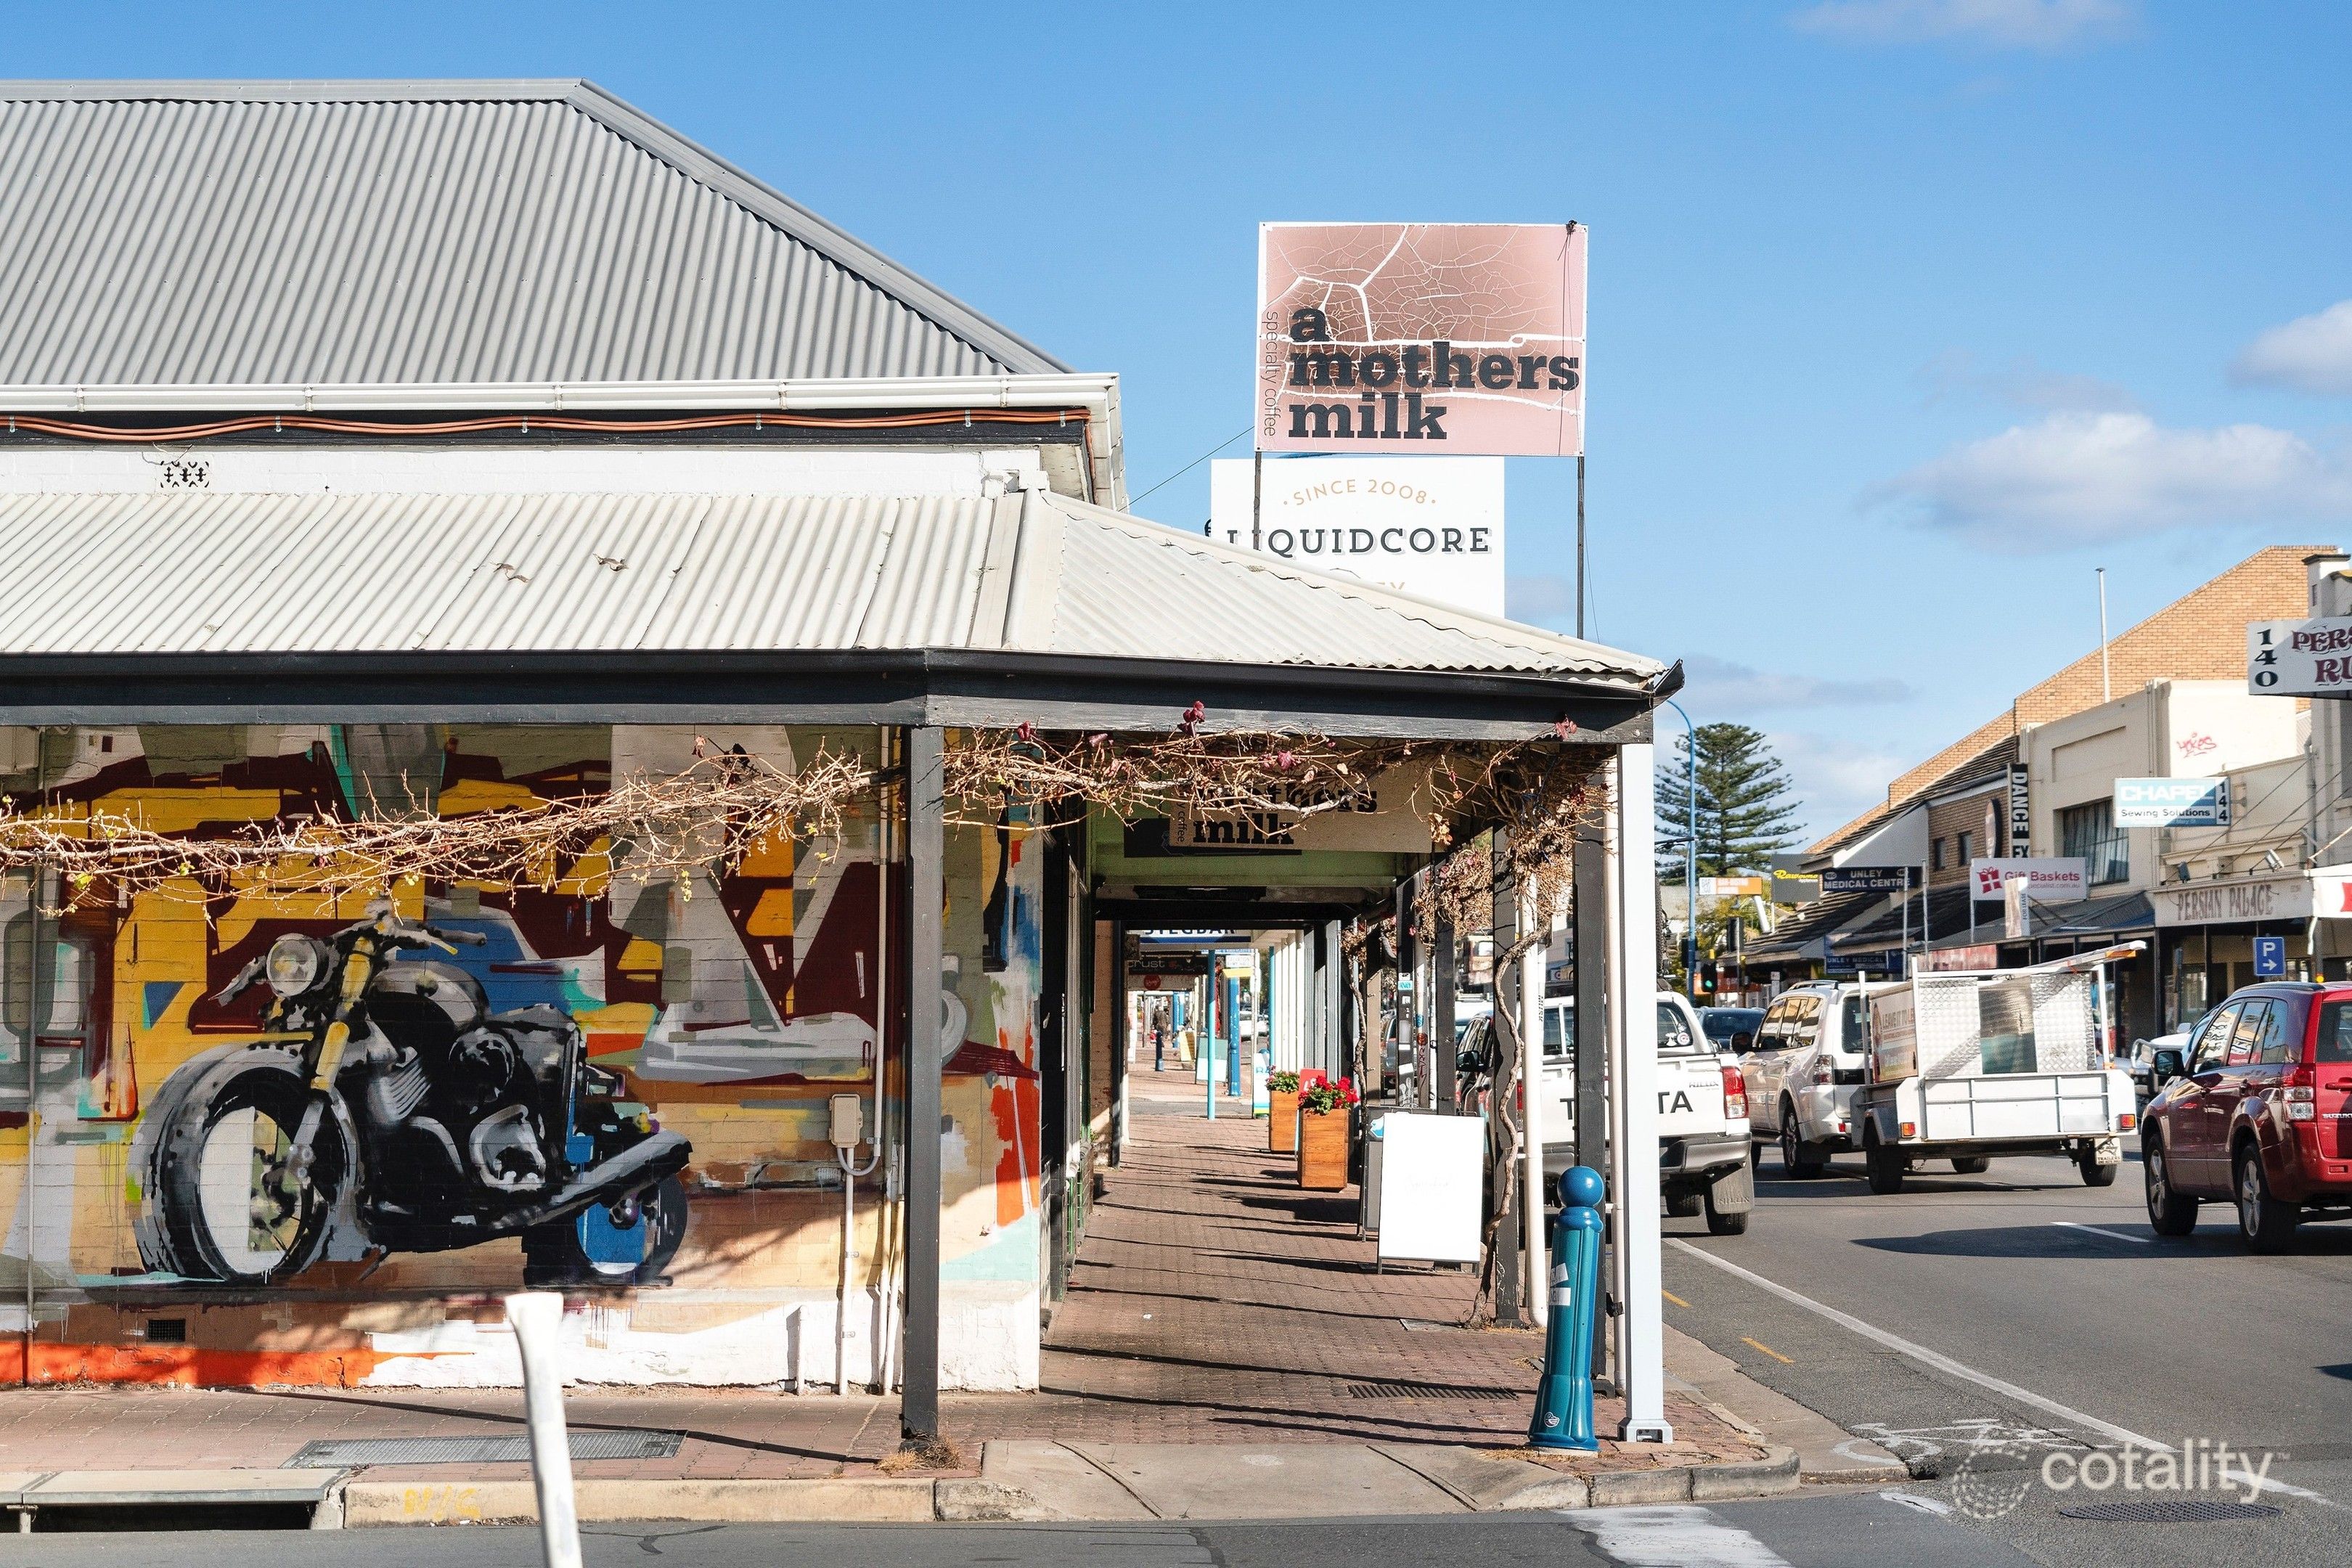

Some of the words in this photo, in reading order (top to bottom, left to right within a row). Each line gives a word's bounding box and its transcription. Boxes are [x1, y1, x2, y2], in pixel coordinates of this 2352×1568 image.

[1290, 308, 1331, 343] a
[1262, 311, 1281, 384] specialty
[1290, 341, 1580, 391] mothers
[1264, 388, 1281, 436] coffee
[1289, 392, 1447, 439] milk
[1294, 479, 1356, 505] SINCE
[1368, 479, 1426, 504] 2008
[1227, 527, 1490, 558] QUIDCORE
[2292, 626, 2352, 652] PER
[2012, 772, 2029, 832] DANCE
[2121, 809, 2158, 817] Sewing
[2163, 808, 2210, 817] Solutions
[1193, 813, 1294, 844] milk
[1824, 879, 1867, 889] MEDICAL
[1850, 870, 1882, 878] UNLEY
[2030, 870, 2081, 881] Baskets
[2178, 888, 2222, 921] PERSIAN
[2229, 883, 2273, 918] PALACE
[1127, 960, 1165, 968] crust
[2263, 942, 2276, 957] P
